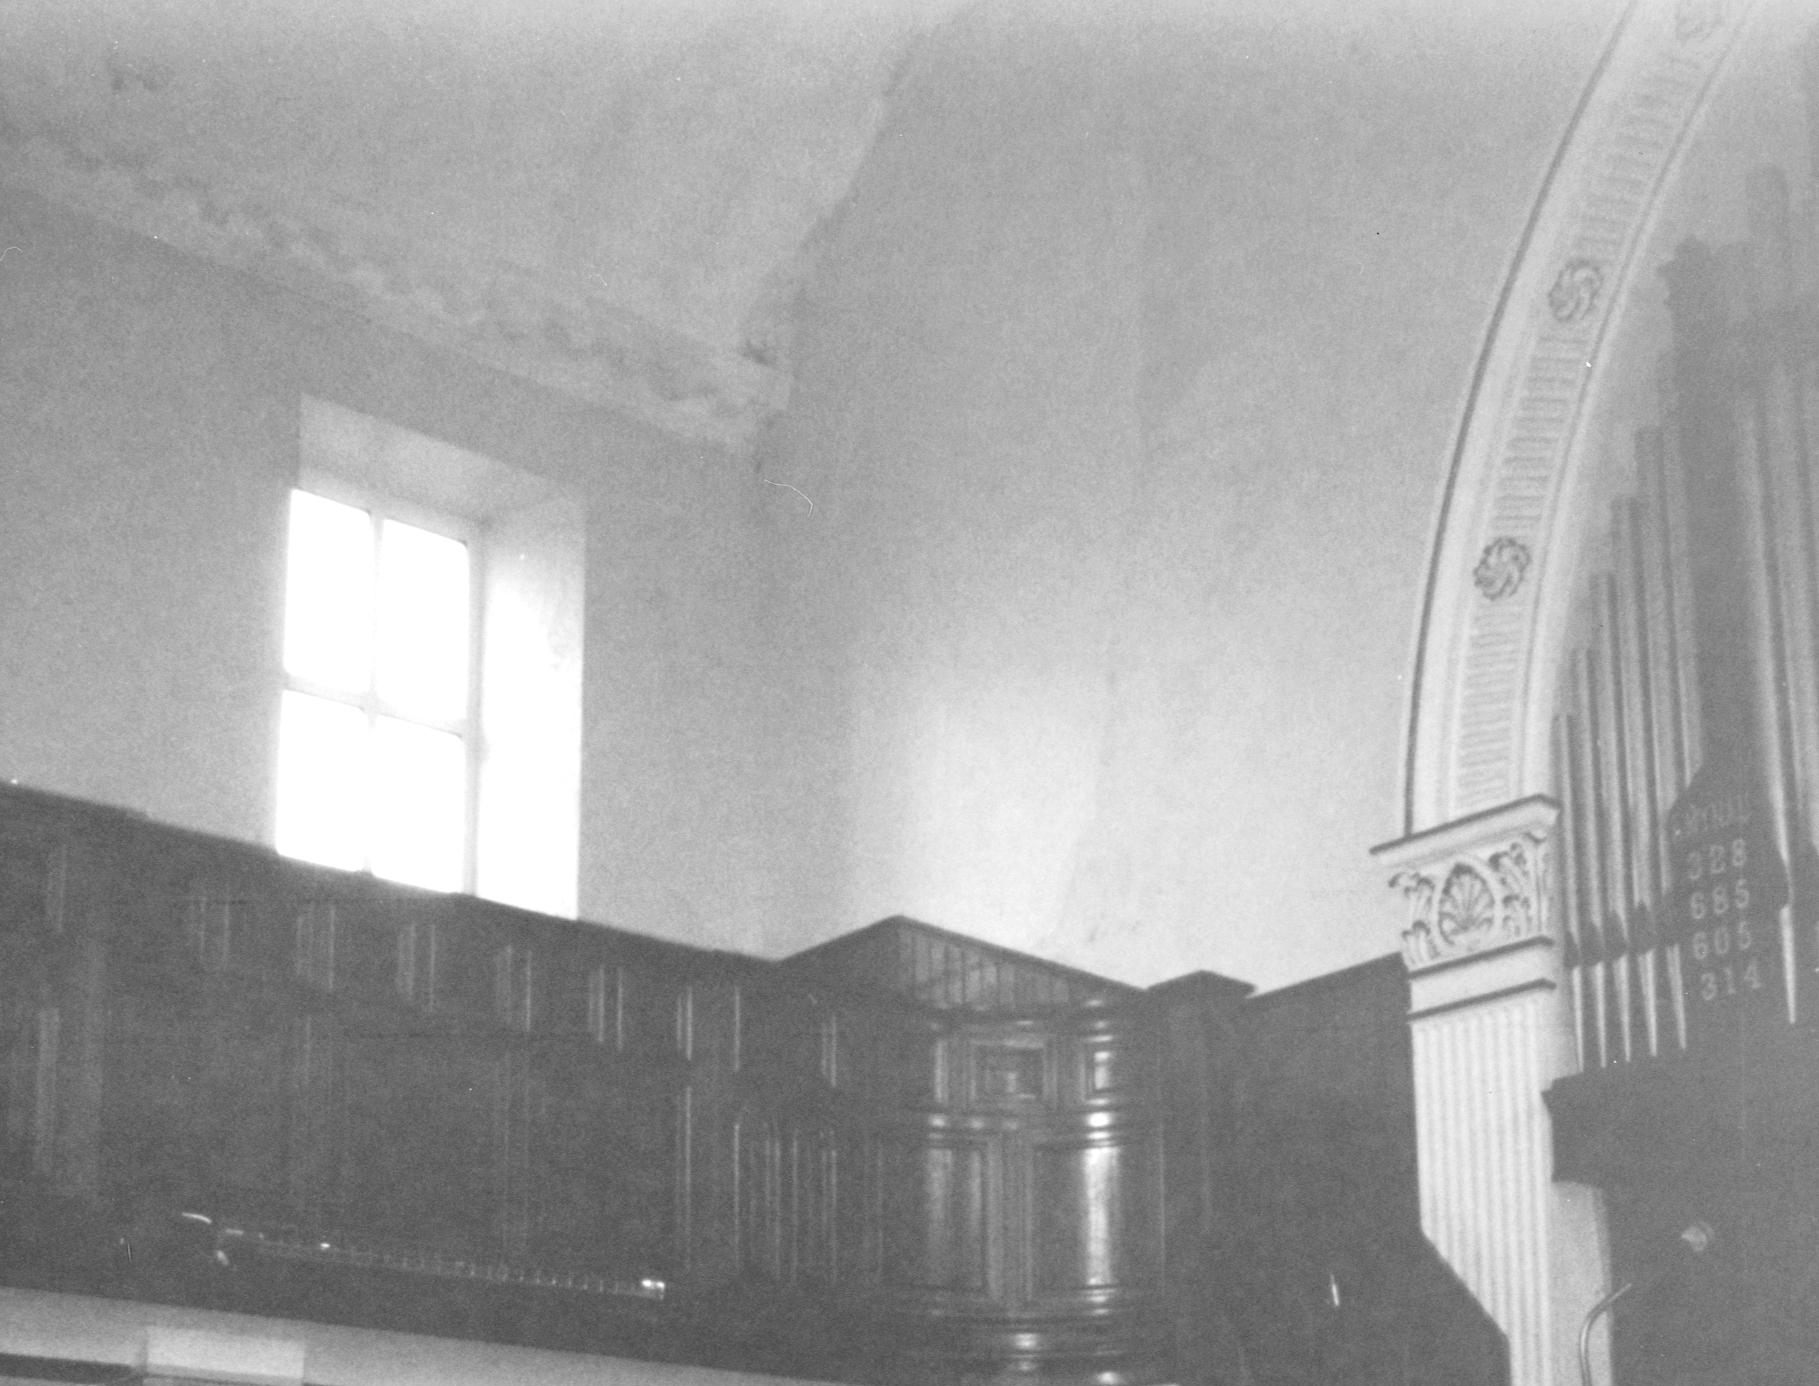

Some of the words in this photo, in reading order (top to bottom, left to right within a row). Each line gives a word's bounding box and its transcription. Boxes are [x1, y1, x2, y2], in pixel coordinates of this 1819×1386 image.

[1690, 878, 1750, 920] 685
[1692, 920, 1752, 960] 605
[1701, 959, 1762, 1001] 314
